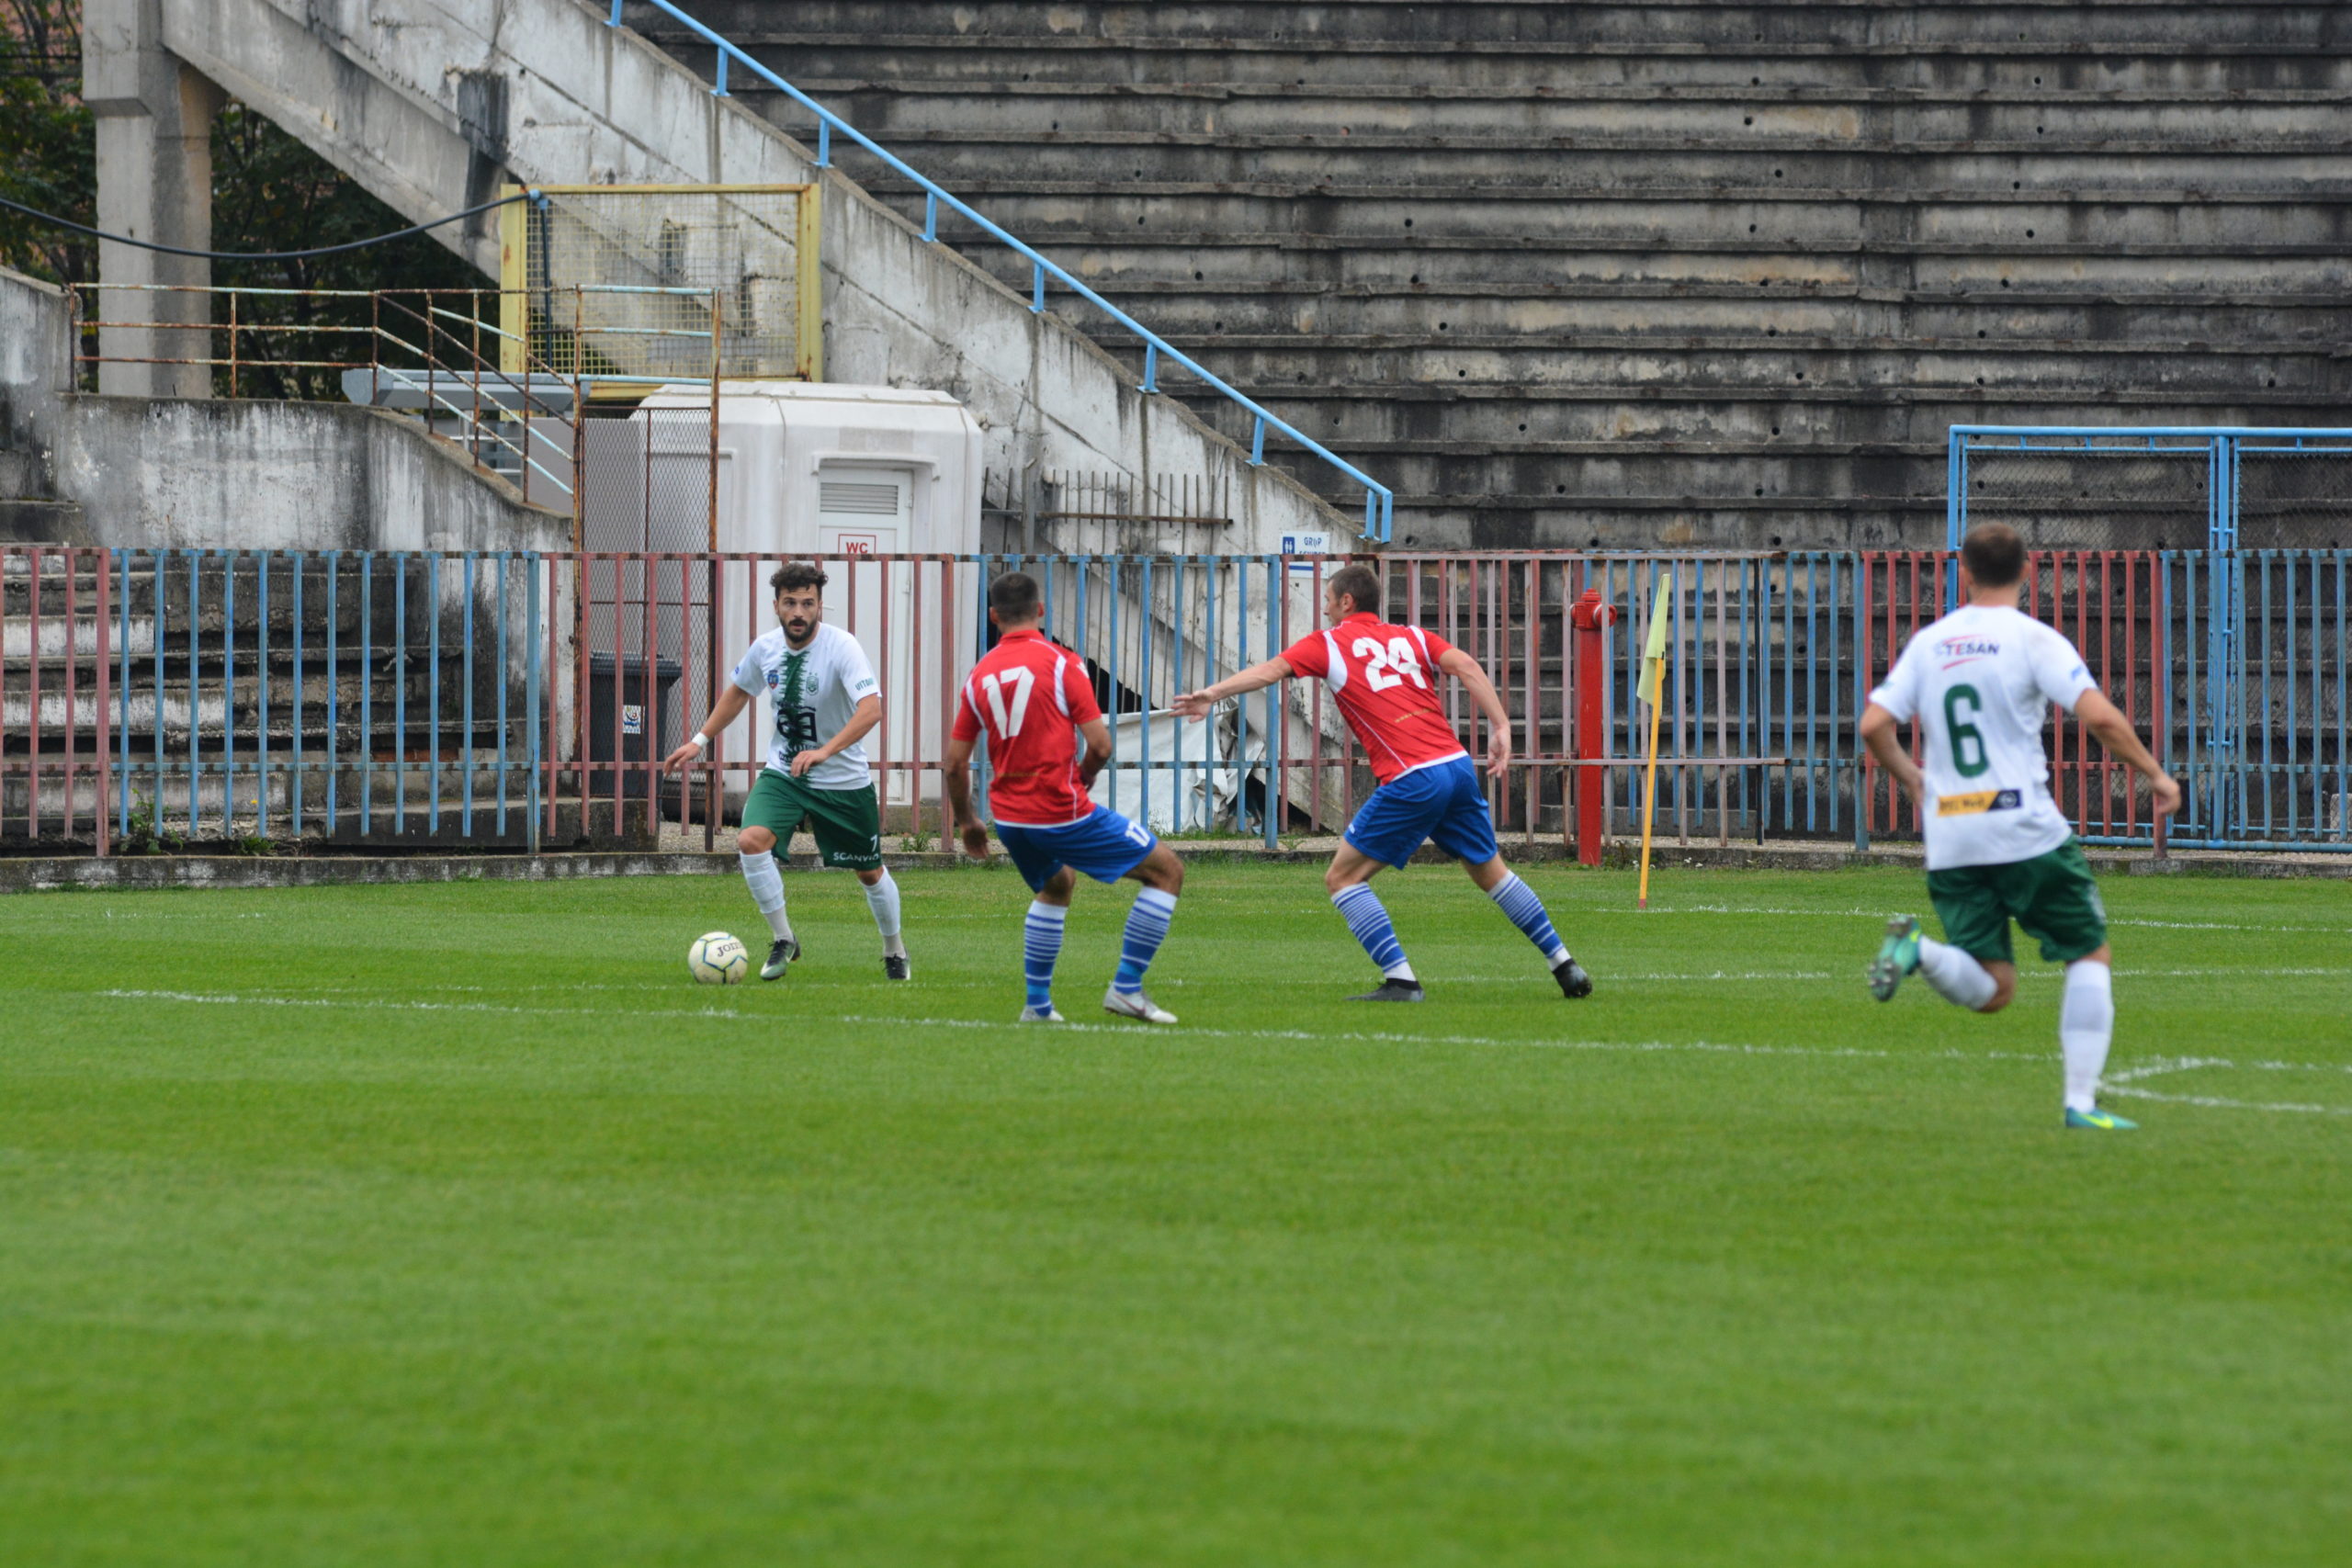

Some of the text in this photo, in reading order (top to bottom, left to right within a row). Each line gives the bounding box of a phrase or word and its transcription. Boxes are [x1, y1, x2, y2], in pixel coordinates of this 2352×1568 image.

[846, 542, 868, 554] WC
[1351, 637, 1428, 693] 24
[982, 665, 1035, 740] 17
[1944, 683, 1989, 780] 6
